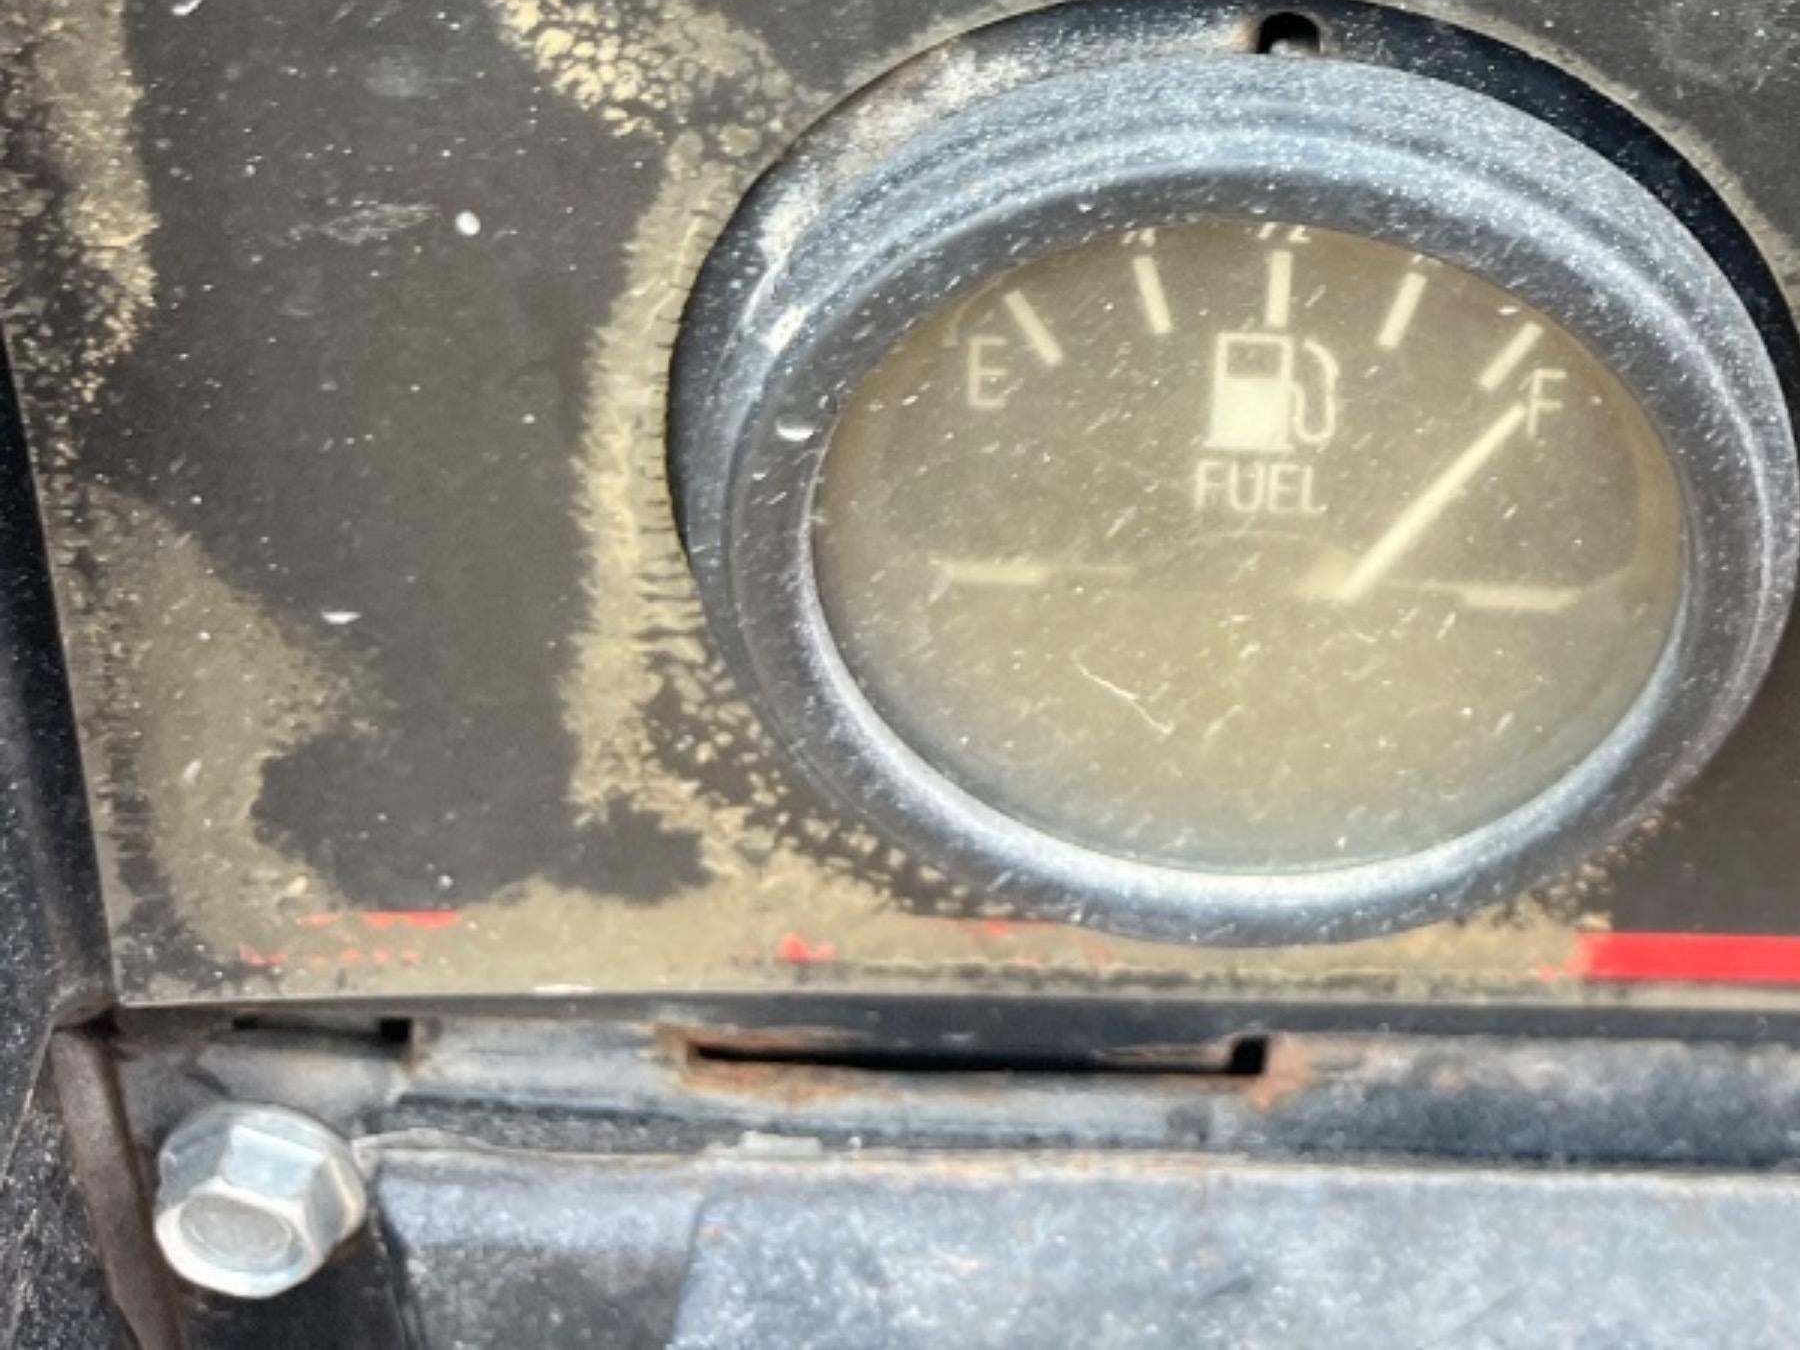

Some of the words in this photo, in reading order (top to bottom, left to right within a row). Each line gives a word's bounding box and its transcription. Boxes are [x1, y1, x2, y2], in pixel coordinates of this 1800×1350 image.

[967, 334, 1009, 410] E
[1527, 367, 1568, 438] F
[1195, 460, 1326, 515] FUEL
